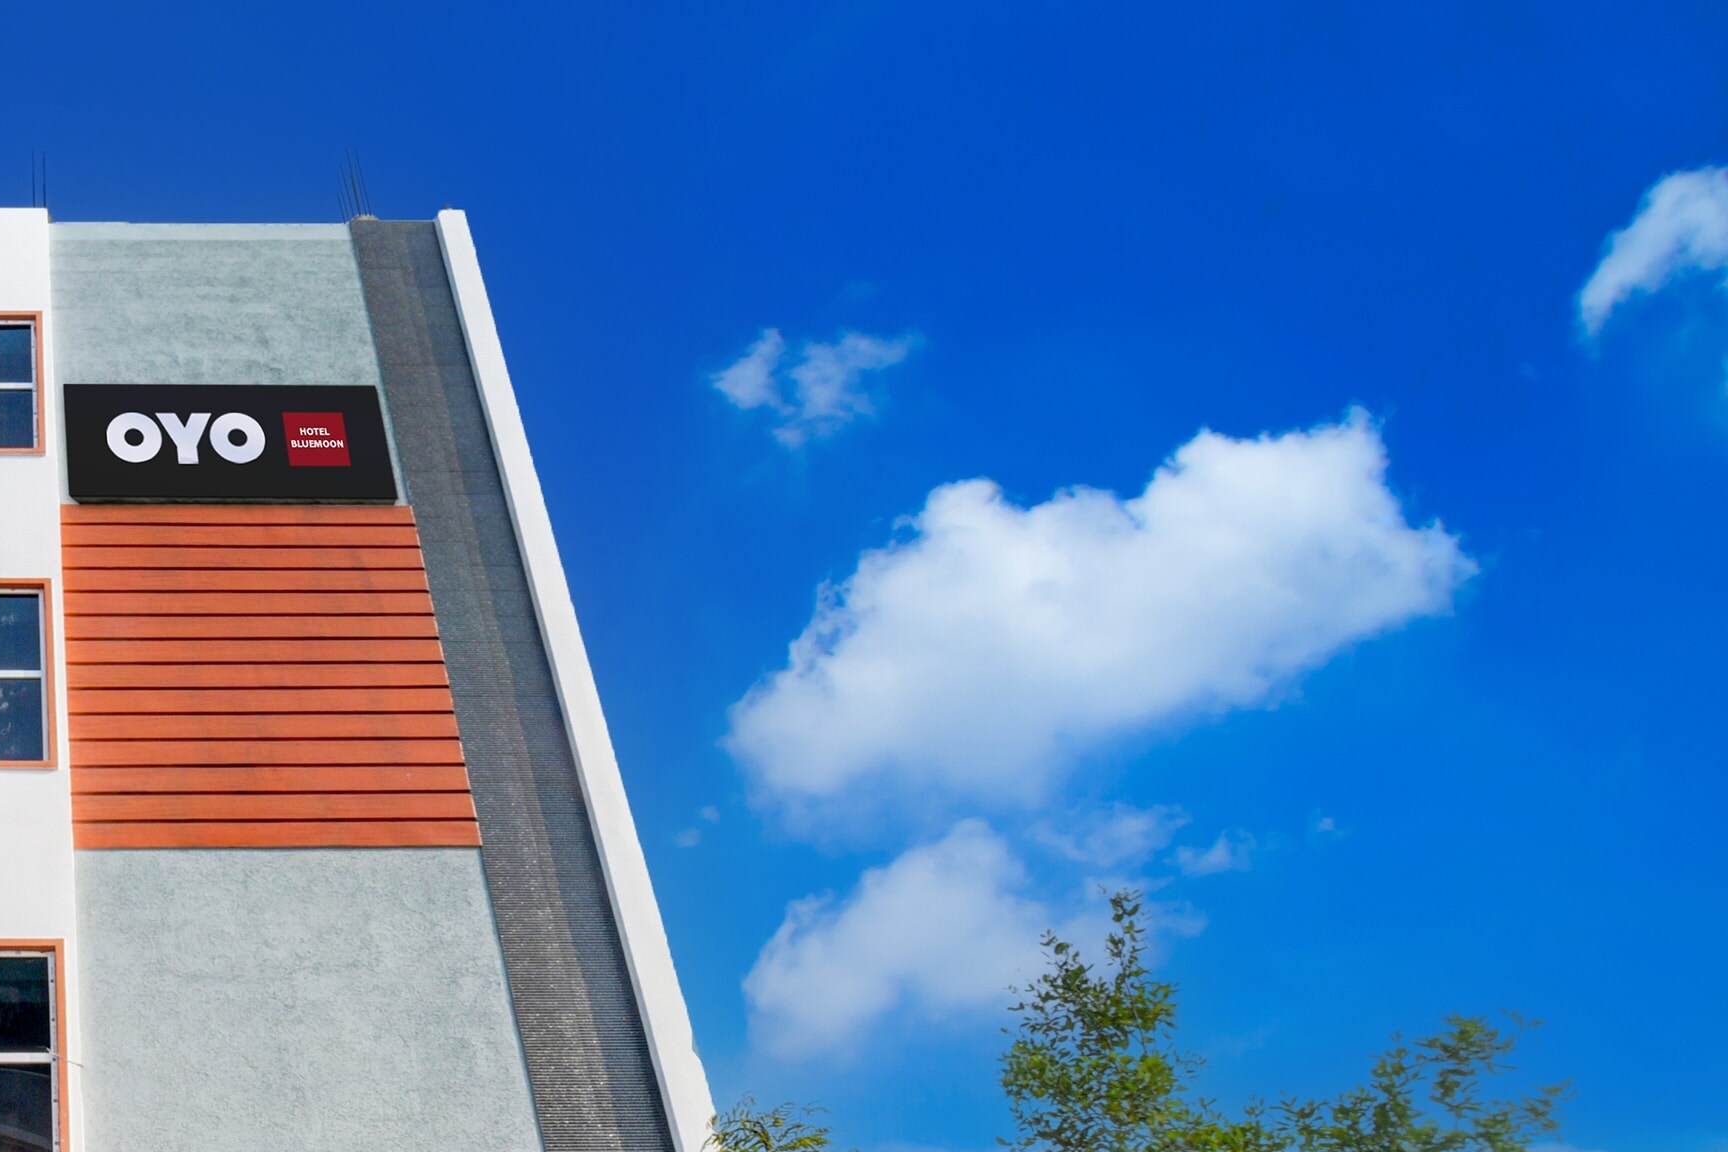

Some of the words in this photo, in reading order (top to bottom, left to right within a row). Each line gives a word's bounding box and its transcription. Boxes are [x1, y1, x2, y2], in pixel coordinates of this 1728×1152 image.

[299, 427, 330, 436] HOTEL
[106, 412, 265, 464] OYO
[290, 439, 344, 448] BLUEMOON
